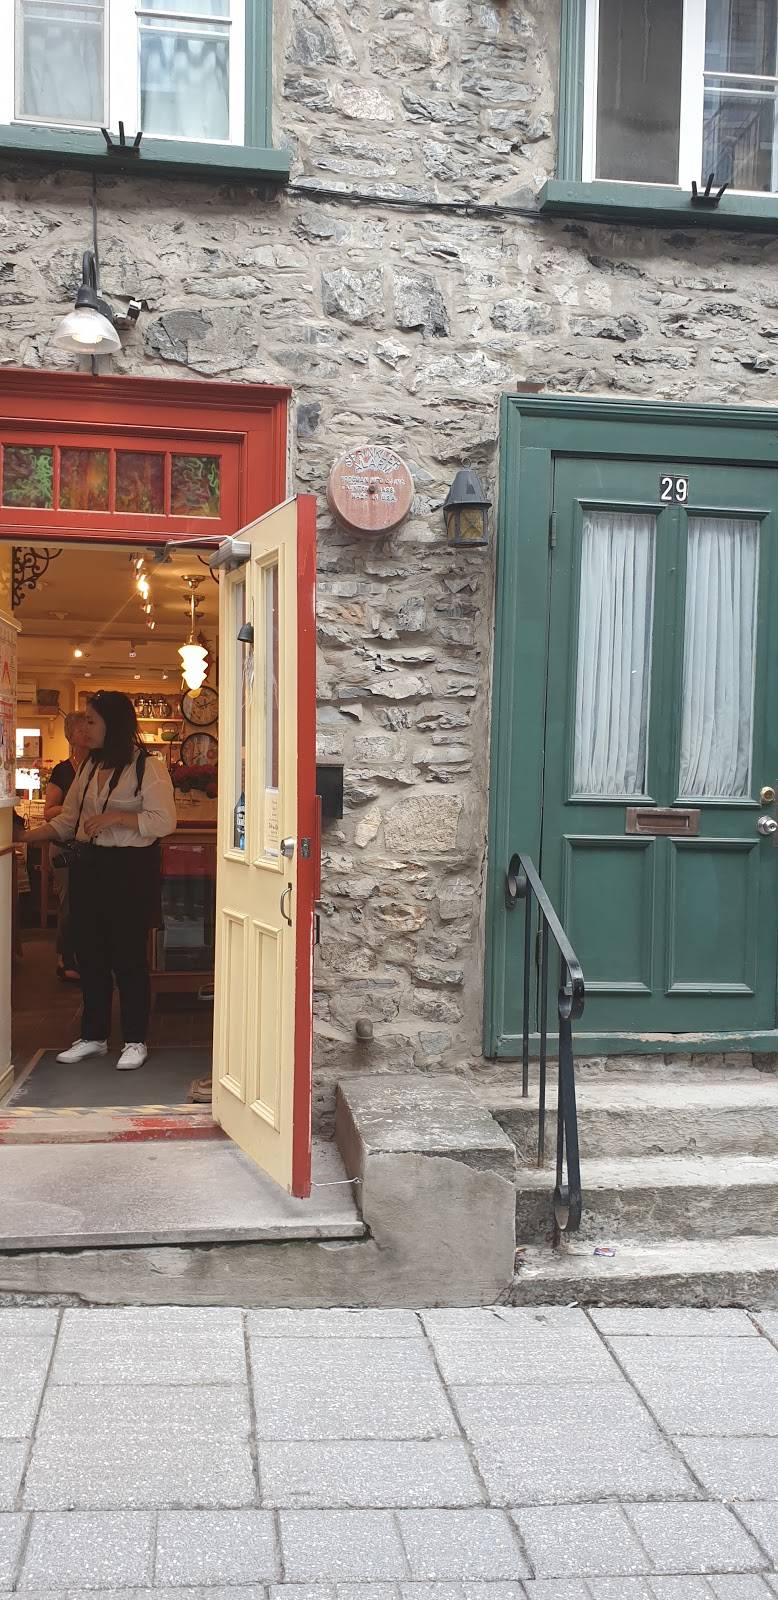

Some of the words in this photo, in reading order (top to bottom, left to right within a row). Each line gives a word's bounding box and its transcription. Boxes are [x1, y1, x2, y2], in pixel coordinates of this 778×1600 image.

[344, 447, 401, 470] SPRINKLER
[355, 457, 392, 474] ALARM
[661, 477, 687, 502] 29
